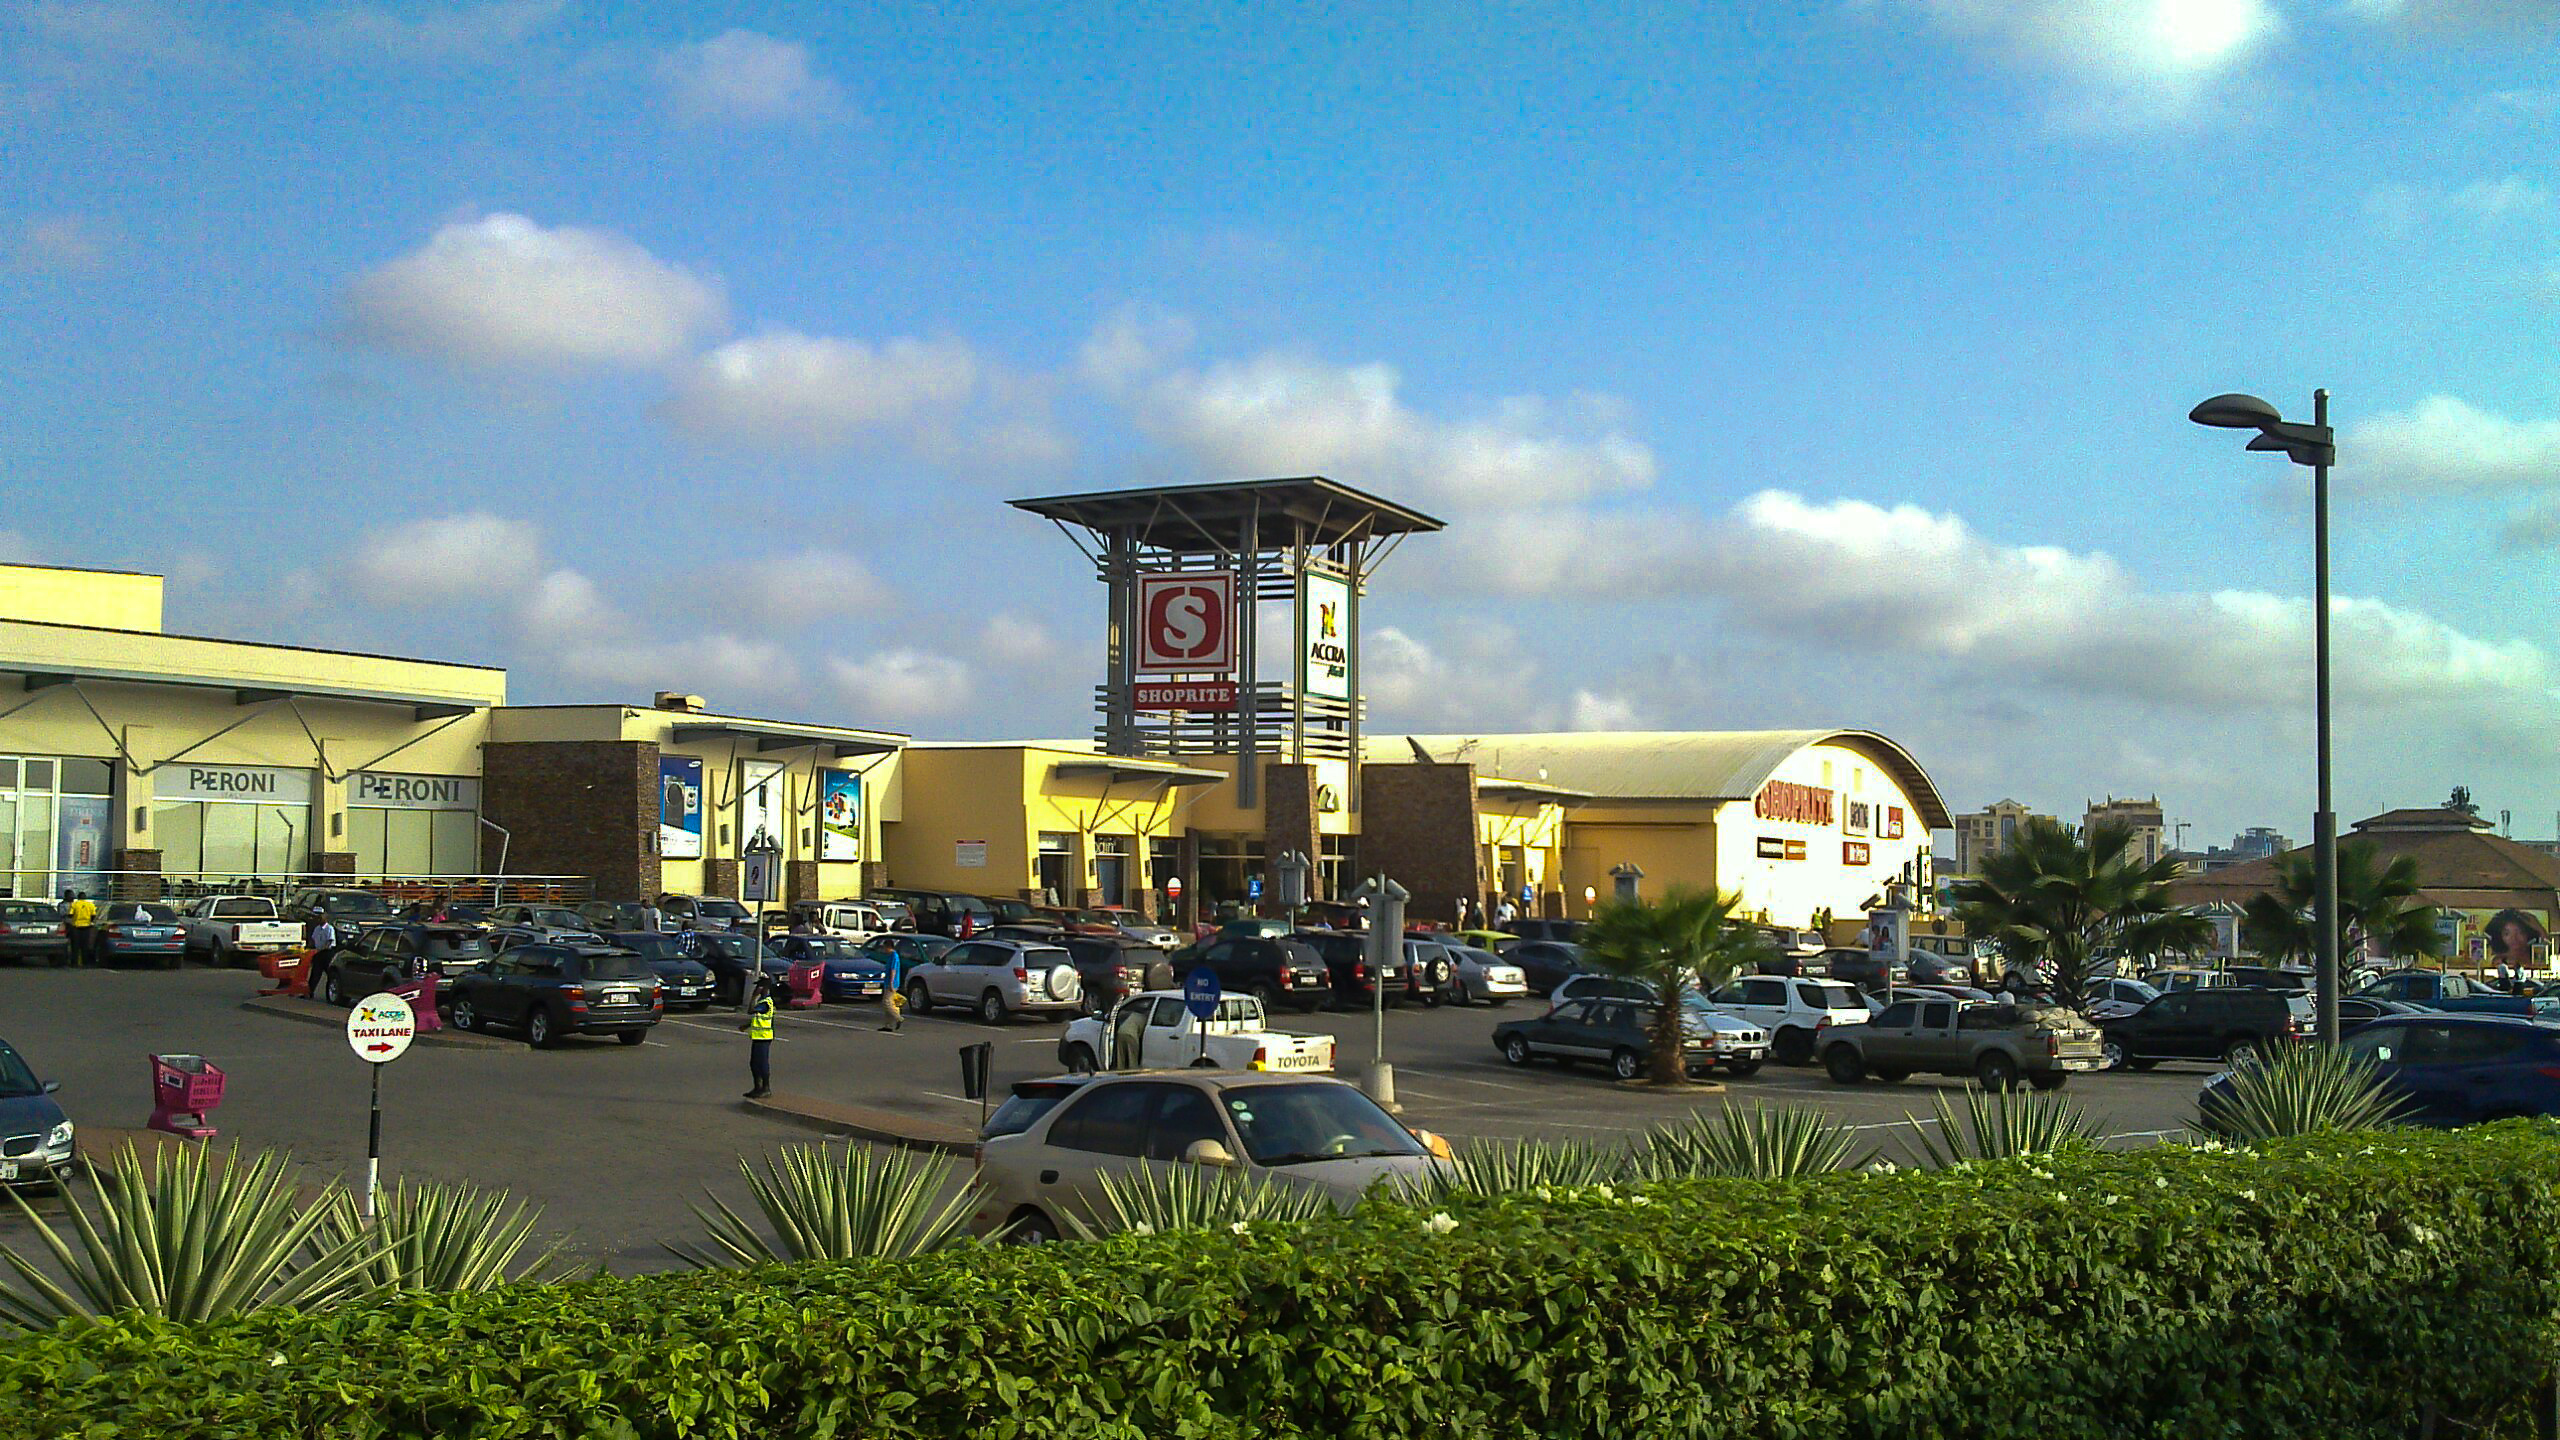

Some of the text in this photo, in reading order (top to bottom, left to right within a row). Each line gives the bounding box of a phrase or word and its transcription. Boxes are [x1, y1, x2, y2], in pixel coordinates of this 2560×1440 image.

[1311, 643, 1346, 664] ACCRA
[1137, 687, 1230, 703] SHOPRITE
[189, 768, 276, 793] PERONI
[358, 774, 460, 802] PERONI
[1755, 780, 1834, 826] SHOPRITE
[1197, 978, 1209, 987] NO
[1190, 991, 1216, 1002] ENTRY
[353, 1028, 412, 1038] TAXI LANE
[1278, 1055, 1320, 1069] TOYOTA
